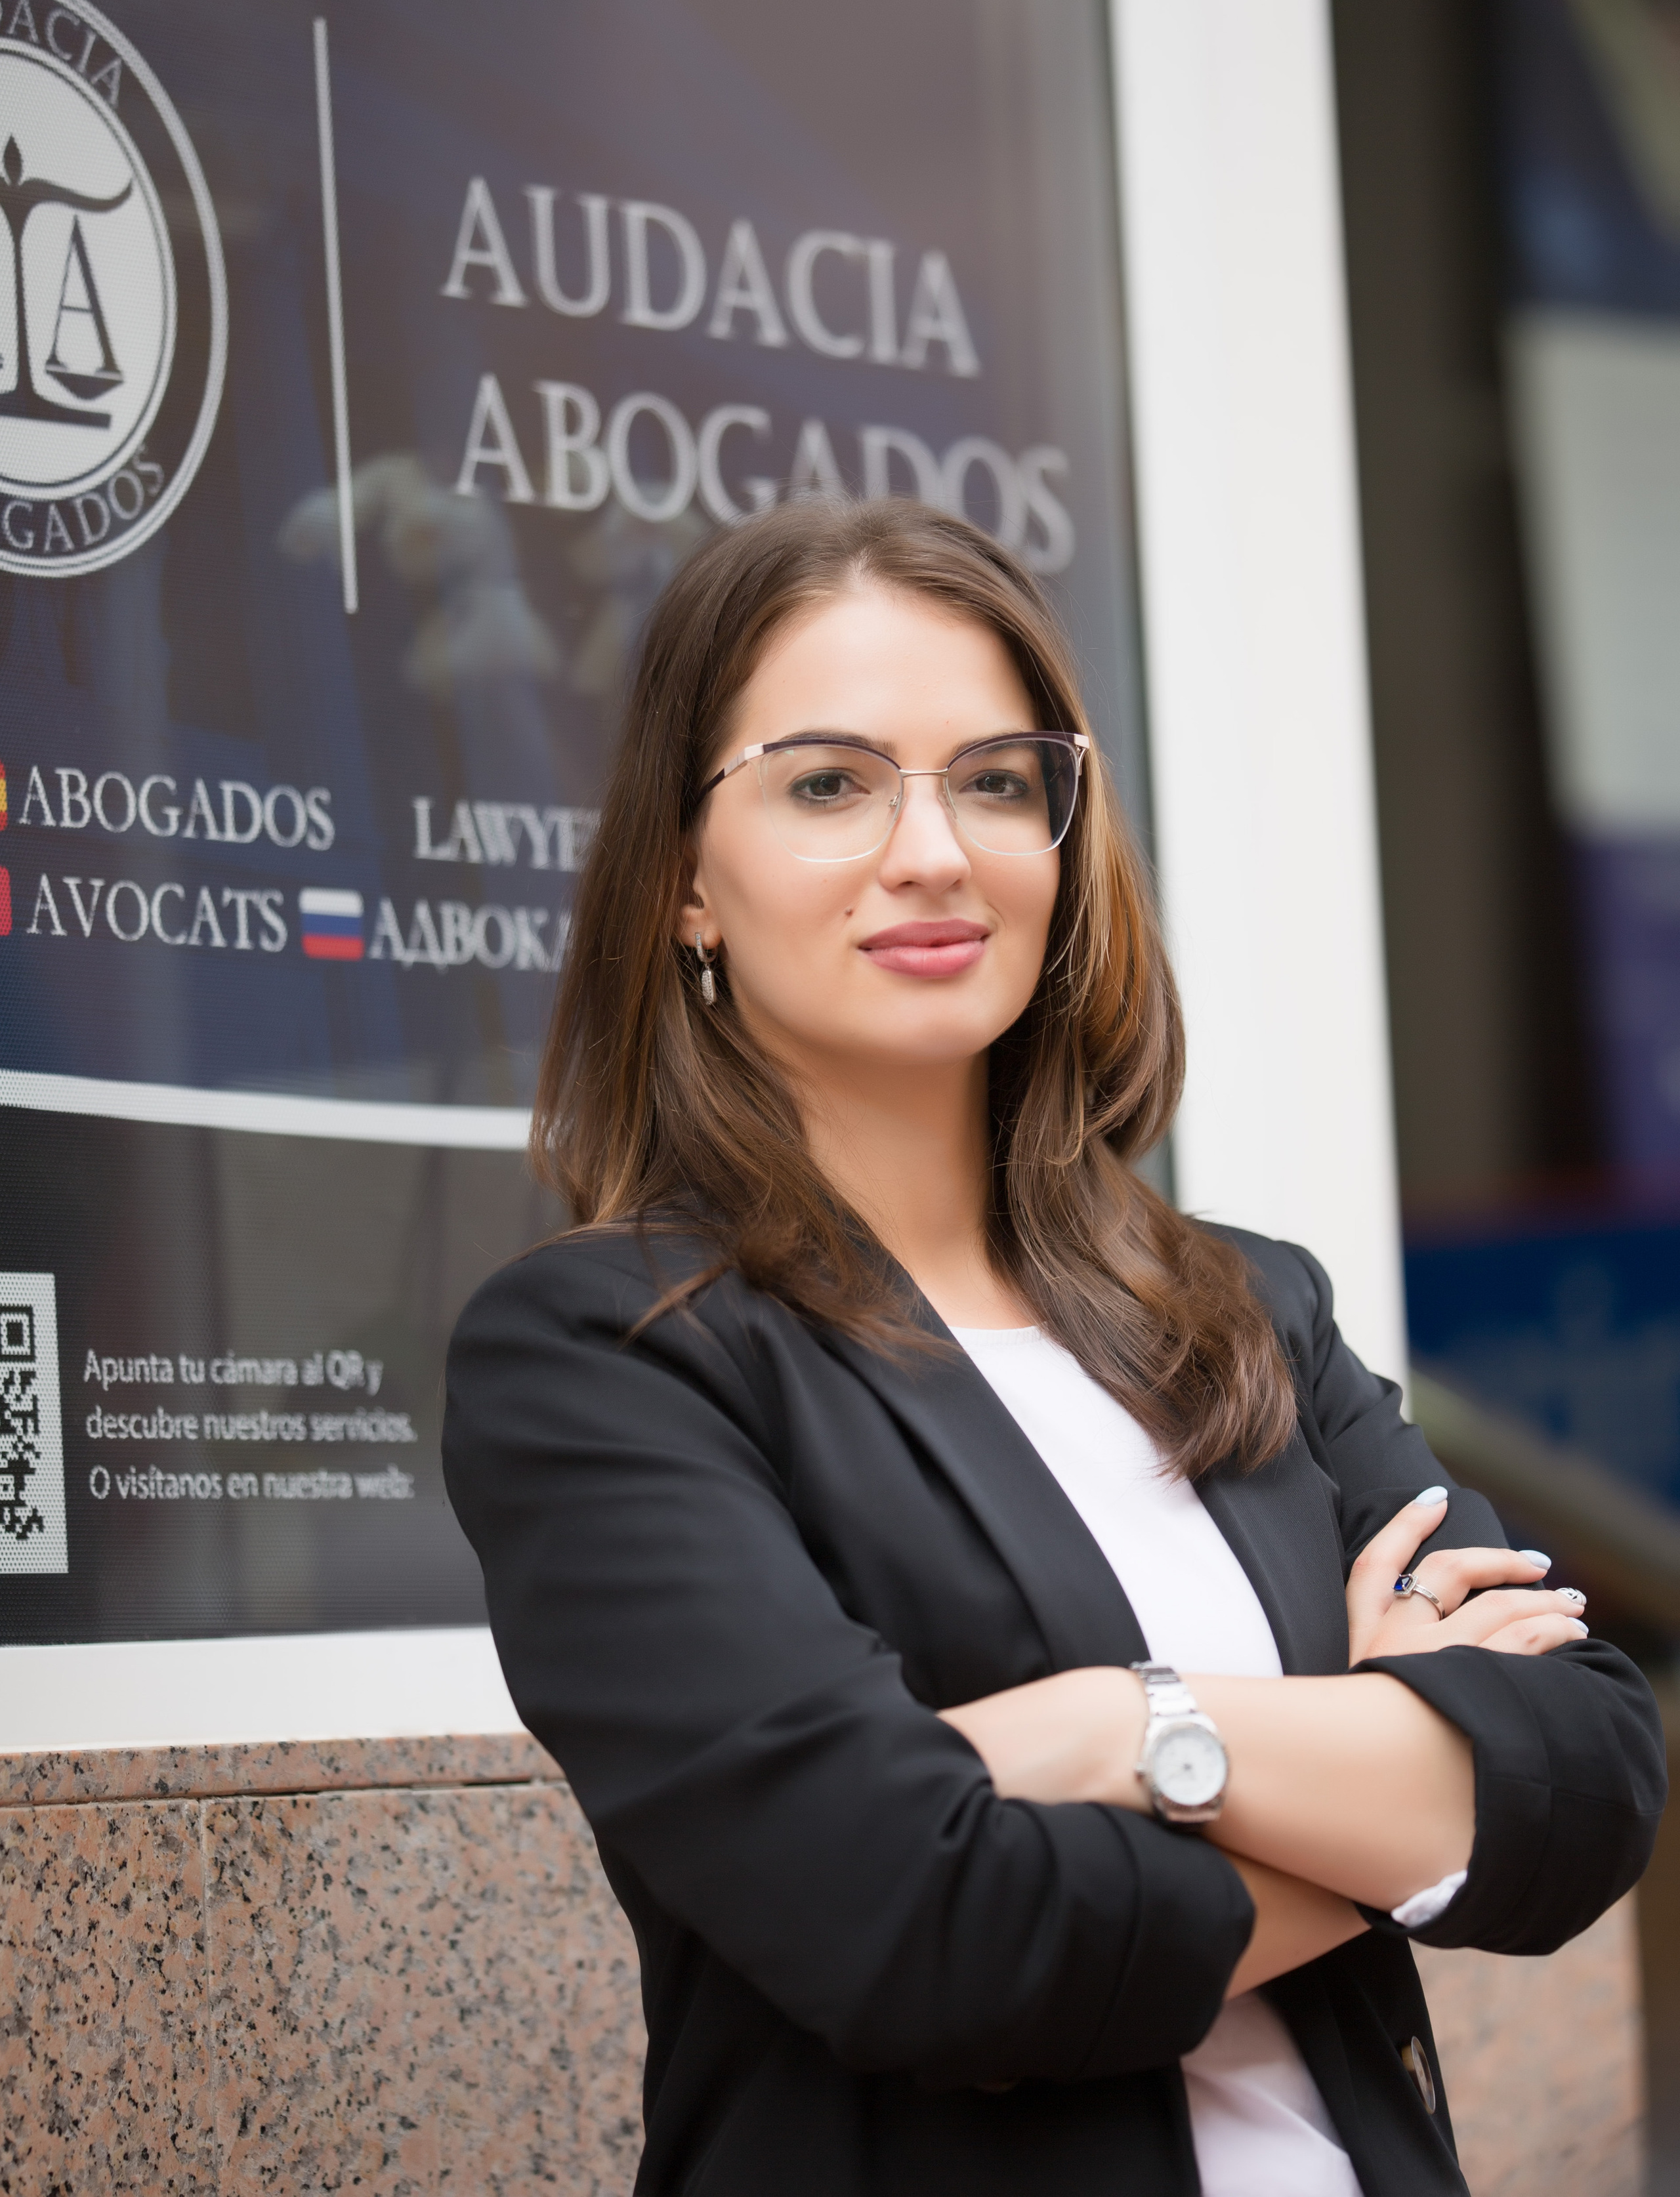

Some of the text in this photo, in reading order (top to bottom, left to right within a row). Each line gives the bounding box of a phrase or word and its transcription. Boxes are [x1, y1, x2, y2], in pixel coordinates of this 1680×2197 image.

[0, 0, 123, 110] ACIA
[440, 176, 982, 379] AUDACIA
[454, 373, 1076, 577] ABOGADOS
[18, 765, 336, 851] ABOGADOS
[26, 873, 289, 953] AVOCATS
[83, 1348, 175, 1392] Apunta
[178, 1353, 206, 1385] tu
[210, 1349, 300, 1387] cámara
[301, 1350, 325, 1387] al
[86, 1405, 199, 1440] descubre
[203, 1410, 307, 1442] nuestros
[89, 1465, 111, 1499] O
[226, 1472, 260, 1500] en
[262, 1468, 354, 1500] nuestra
